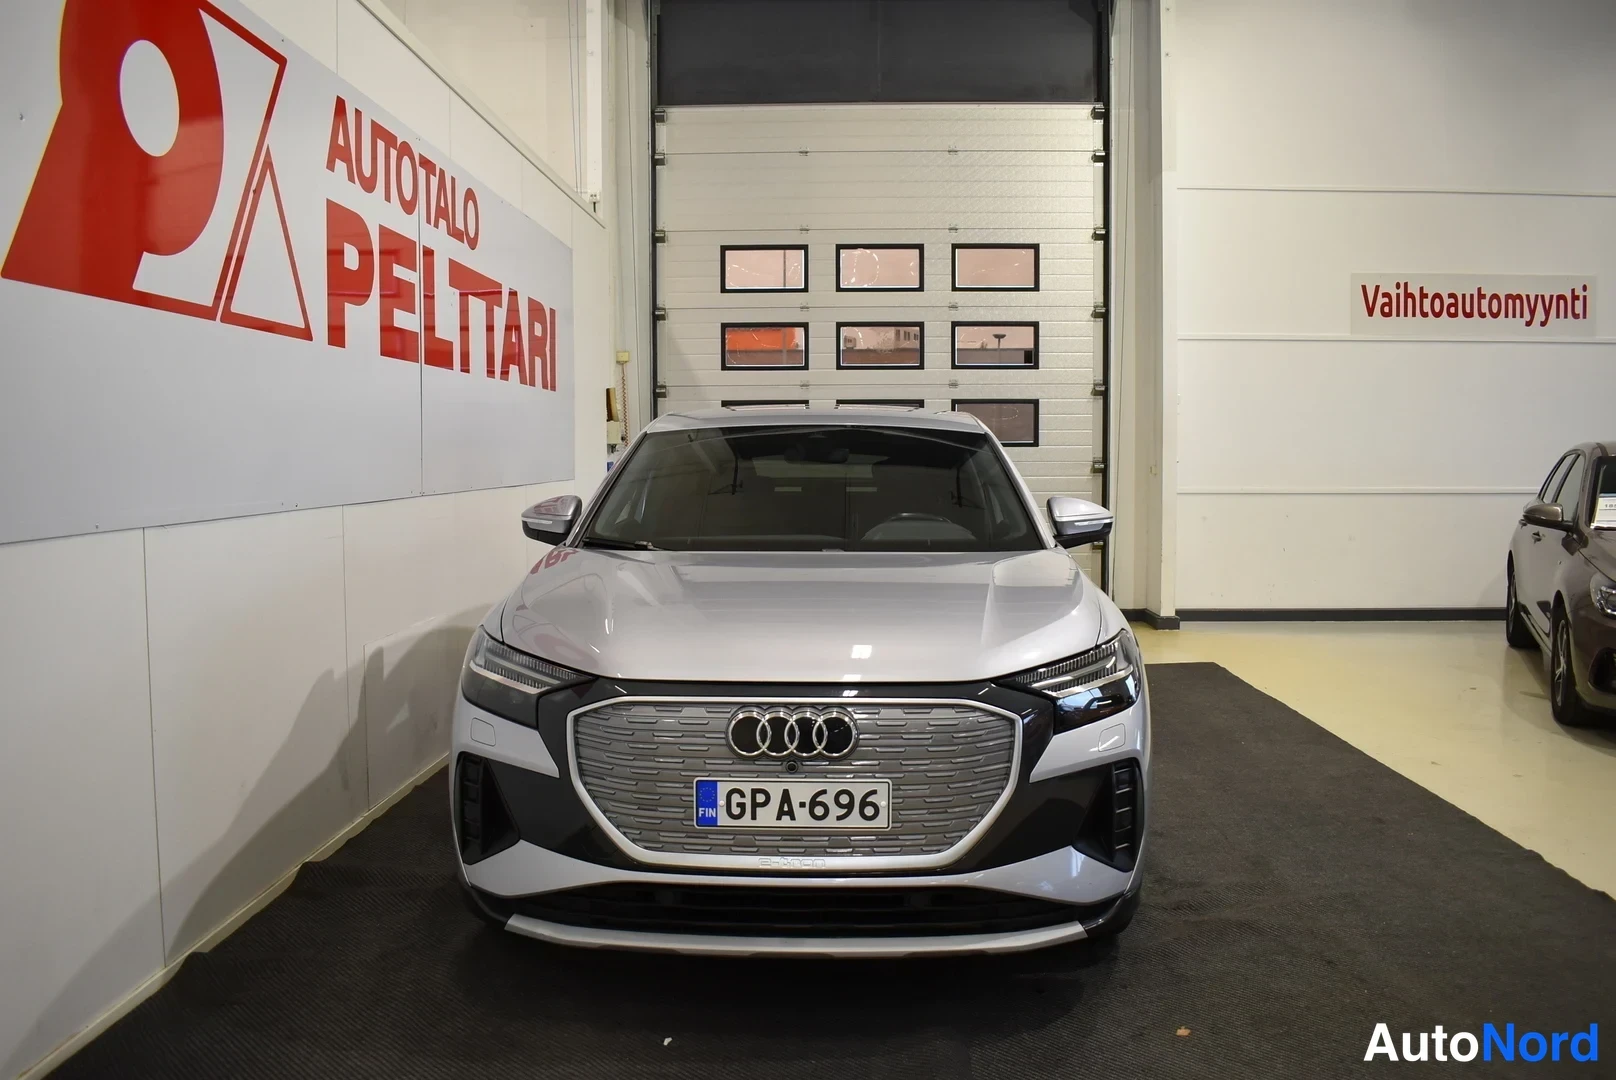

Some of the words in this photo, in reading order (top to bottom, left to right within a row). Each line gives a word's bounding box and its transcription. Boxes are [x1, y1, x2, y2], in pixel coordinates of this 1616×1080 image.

[326, 94, 479, 250] AUTOTALO
[326, 197, 557, 392] PELTTARI
[1361, 281, 1588, 327] Vaihtoautomyynti
[698, 807, 717, 818] FIN
[725, 787, 880, 822] GPA-696
[758, 856, 826, 868] e-tron
